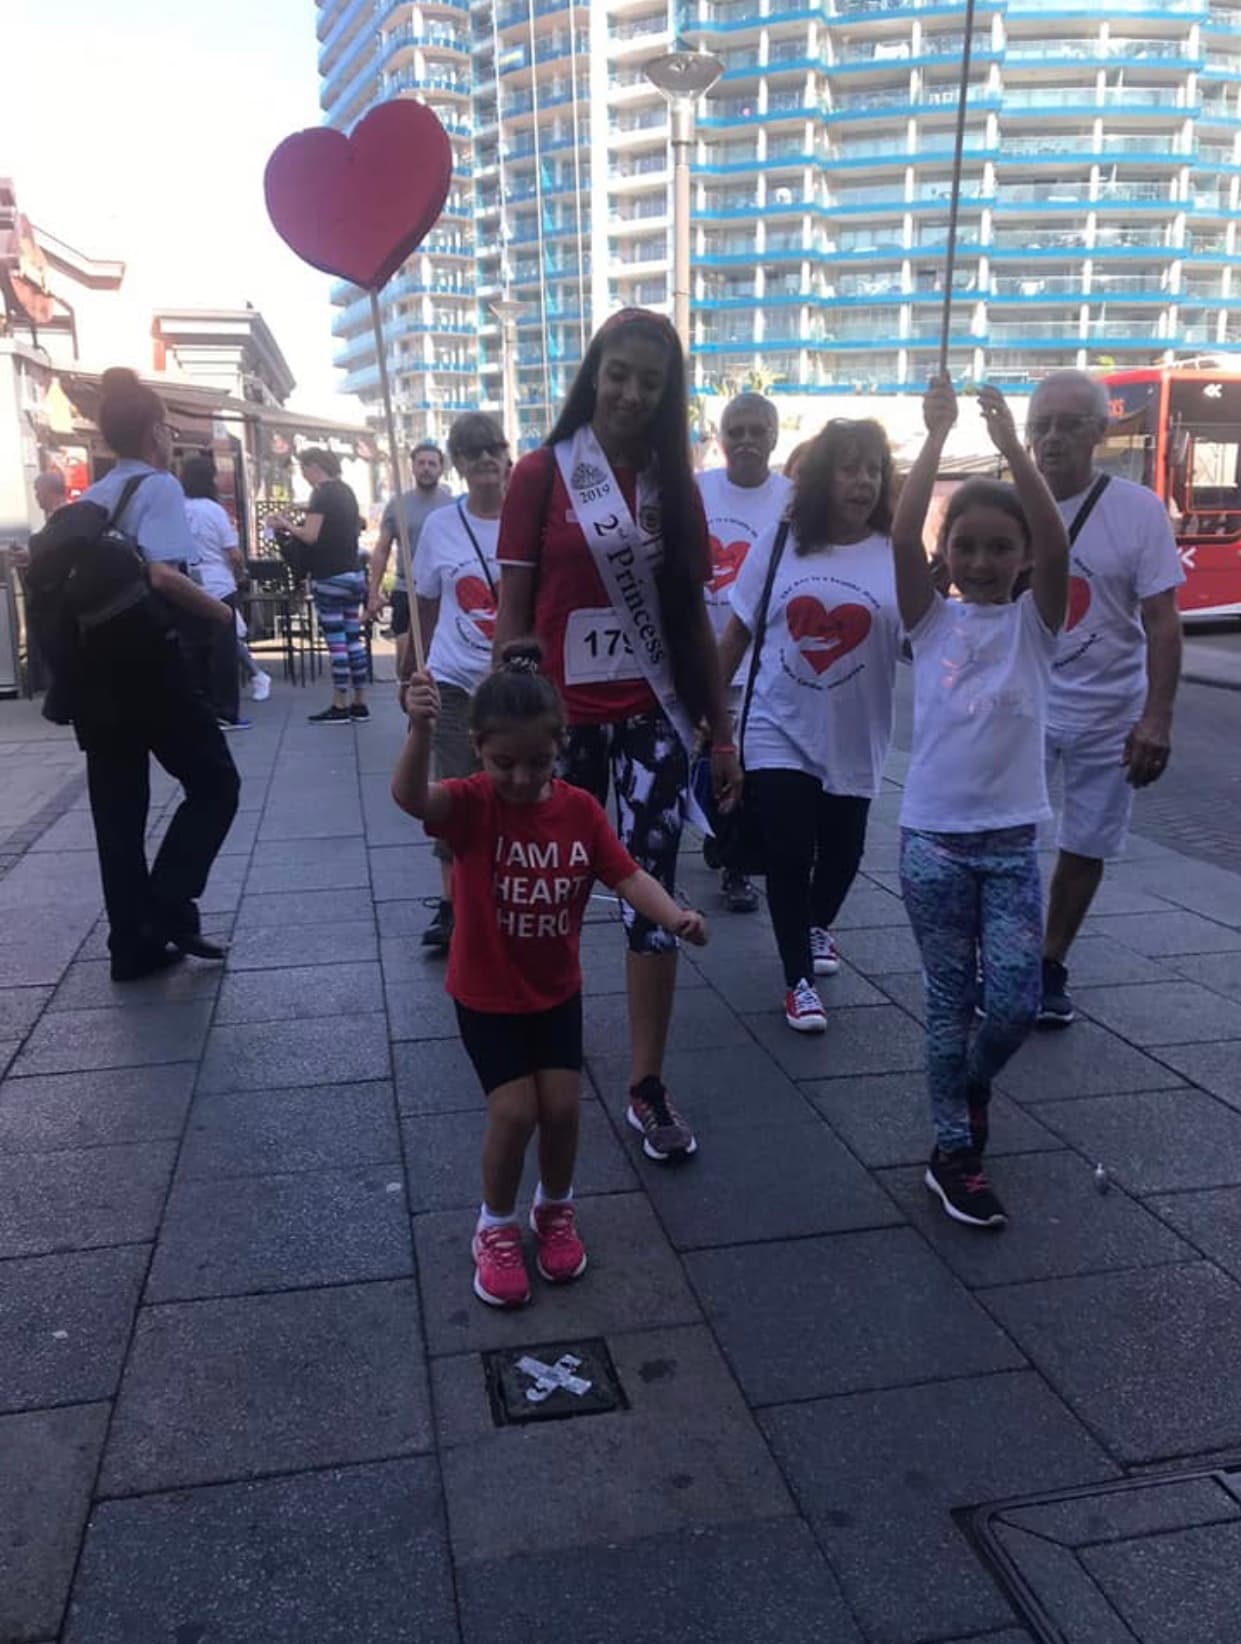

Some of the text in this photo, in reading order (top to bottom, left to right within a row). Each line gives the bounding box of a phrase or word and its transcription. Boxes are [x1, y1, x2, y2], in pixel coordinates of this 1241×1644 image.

[579, 483, 610, 504] 2019
[606, 545, 668, 664] Princess
[495, 836, 590, 868] I AM A
[492, 873, 588, 904] HEART
[496, 908, 569, 937] HERO
